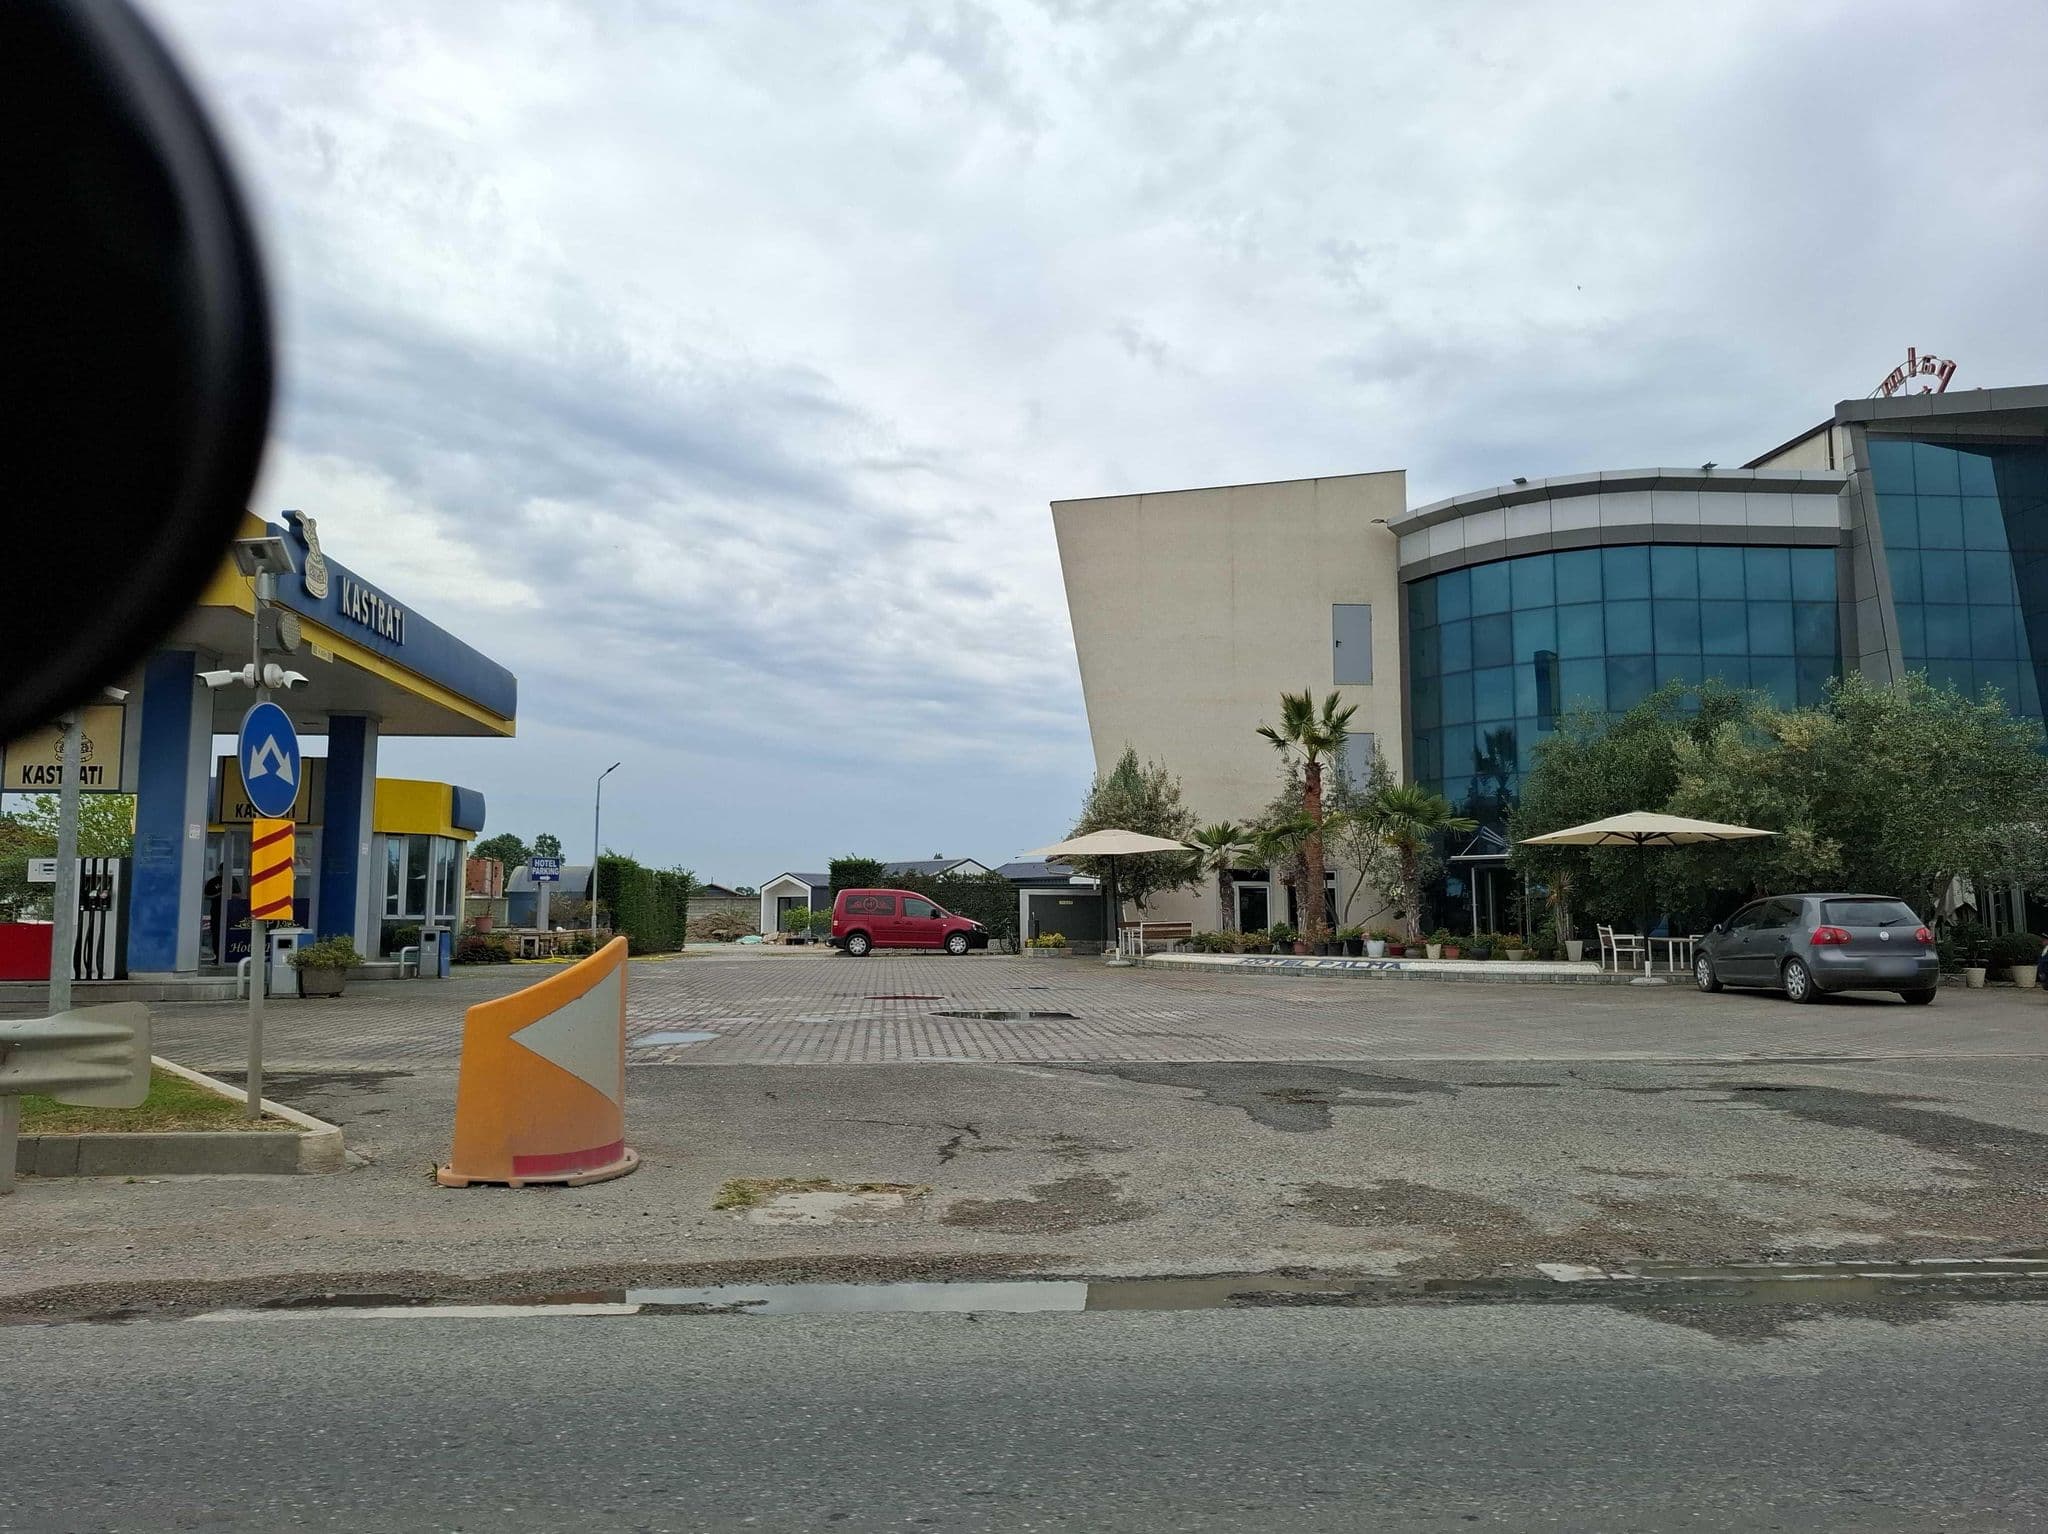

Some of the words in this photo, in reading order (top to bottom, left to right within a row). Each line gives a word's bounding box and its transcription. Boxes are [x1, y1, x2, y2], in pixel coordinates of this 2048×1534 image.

[342, 576, 405, 646] KASTRATI
[22, 765, 103, 785] KASTATI
[534, 859, 557, 868] HOTEL
[532, 867, 559, 875] PARKING
